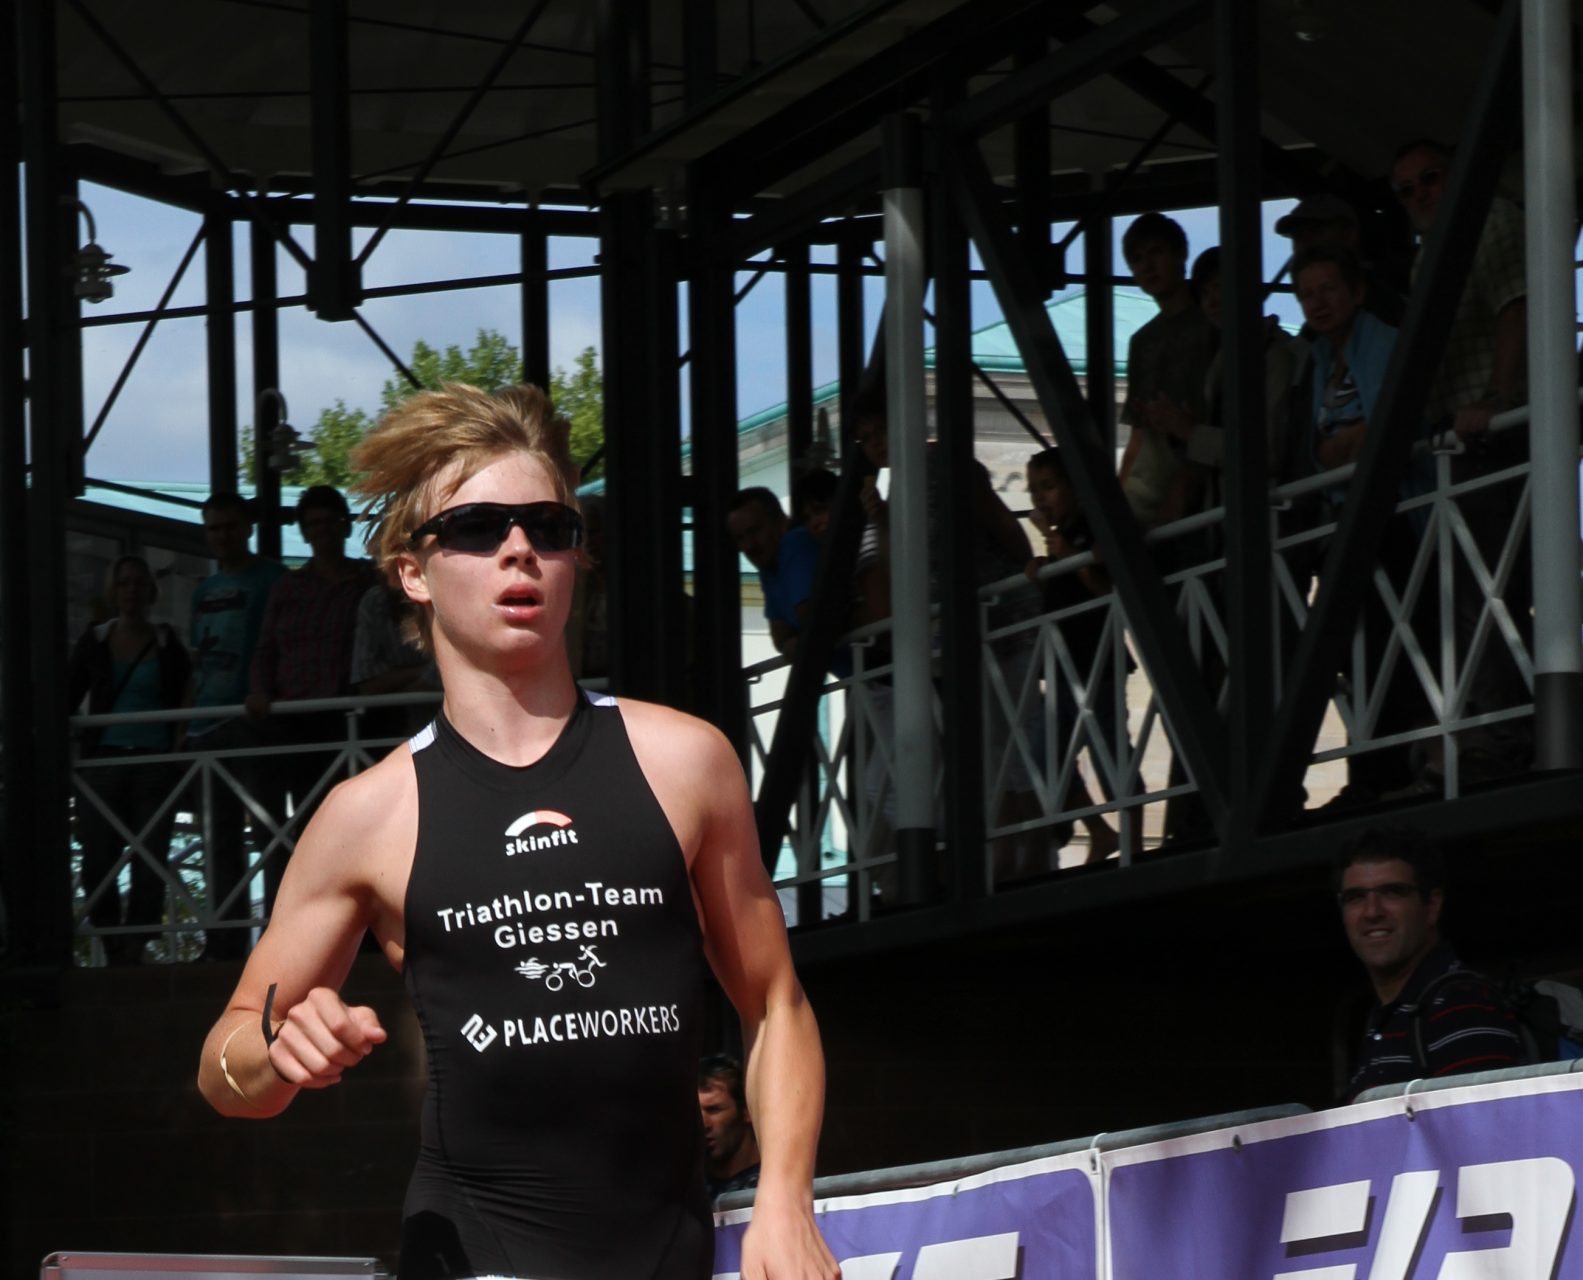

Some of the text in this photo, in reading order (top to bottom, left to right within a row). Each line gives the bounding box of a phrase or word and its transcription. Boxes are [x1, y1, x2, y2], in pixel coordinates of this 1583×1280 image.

[505, 829, 579, 857] skinfit
[437, 882, 664, 932] Triathlon-Team
[494, 919, 619, 949] Giessen
[503, 1004, 680, 1047] PLACEWORKERS
